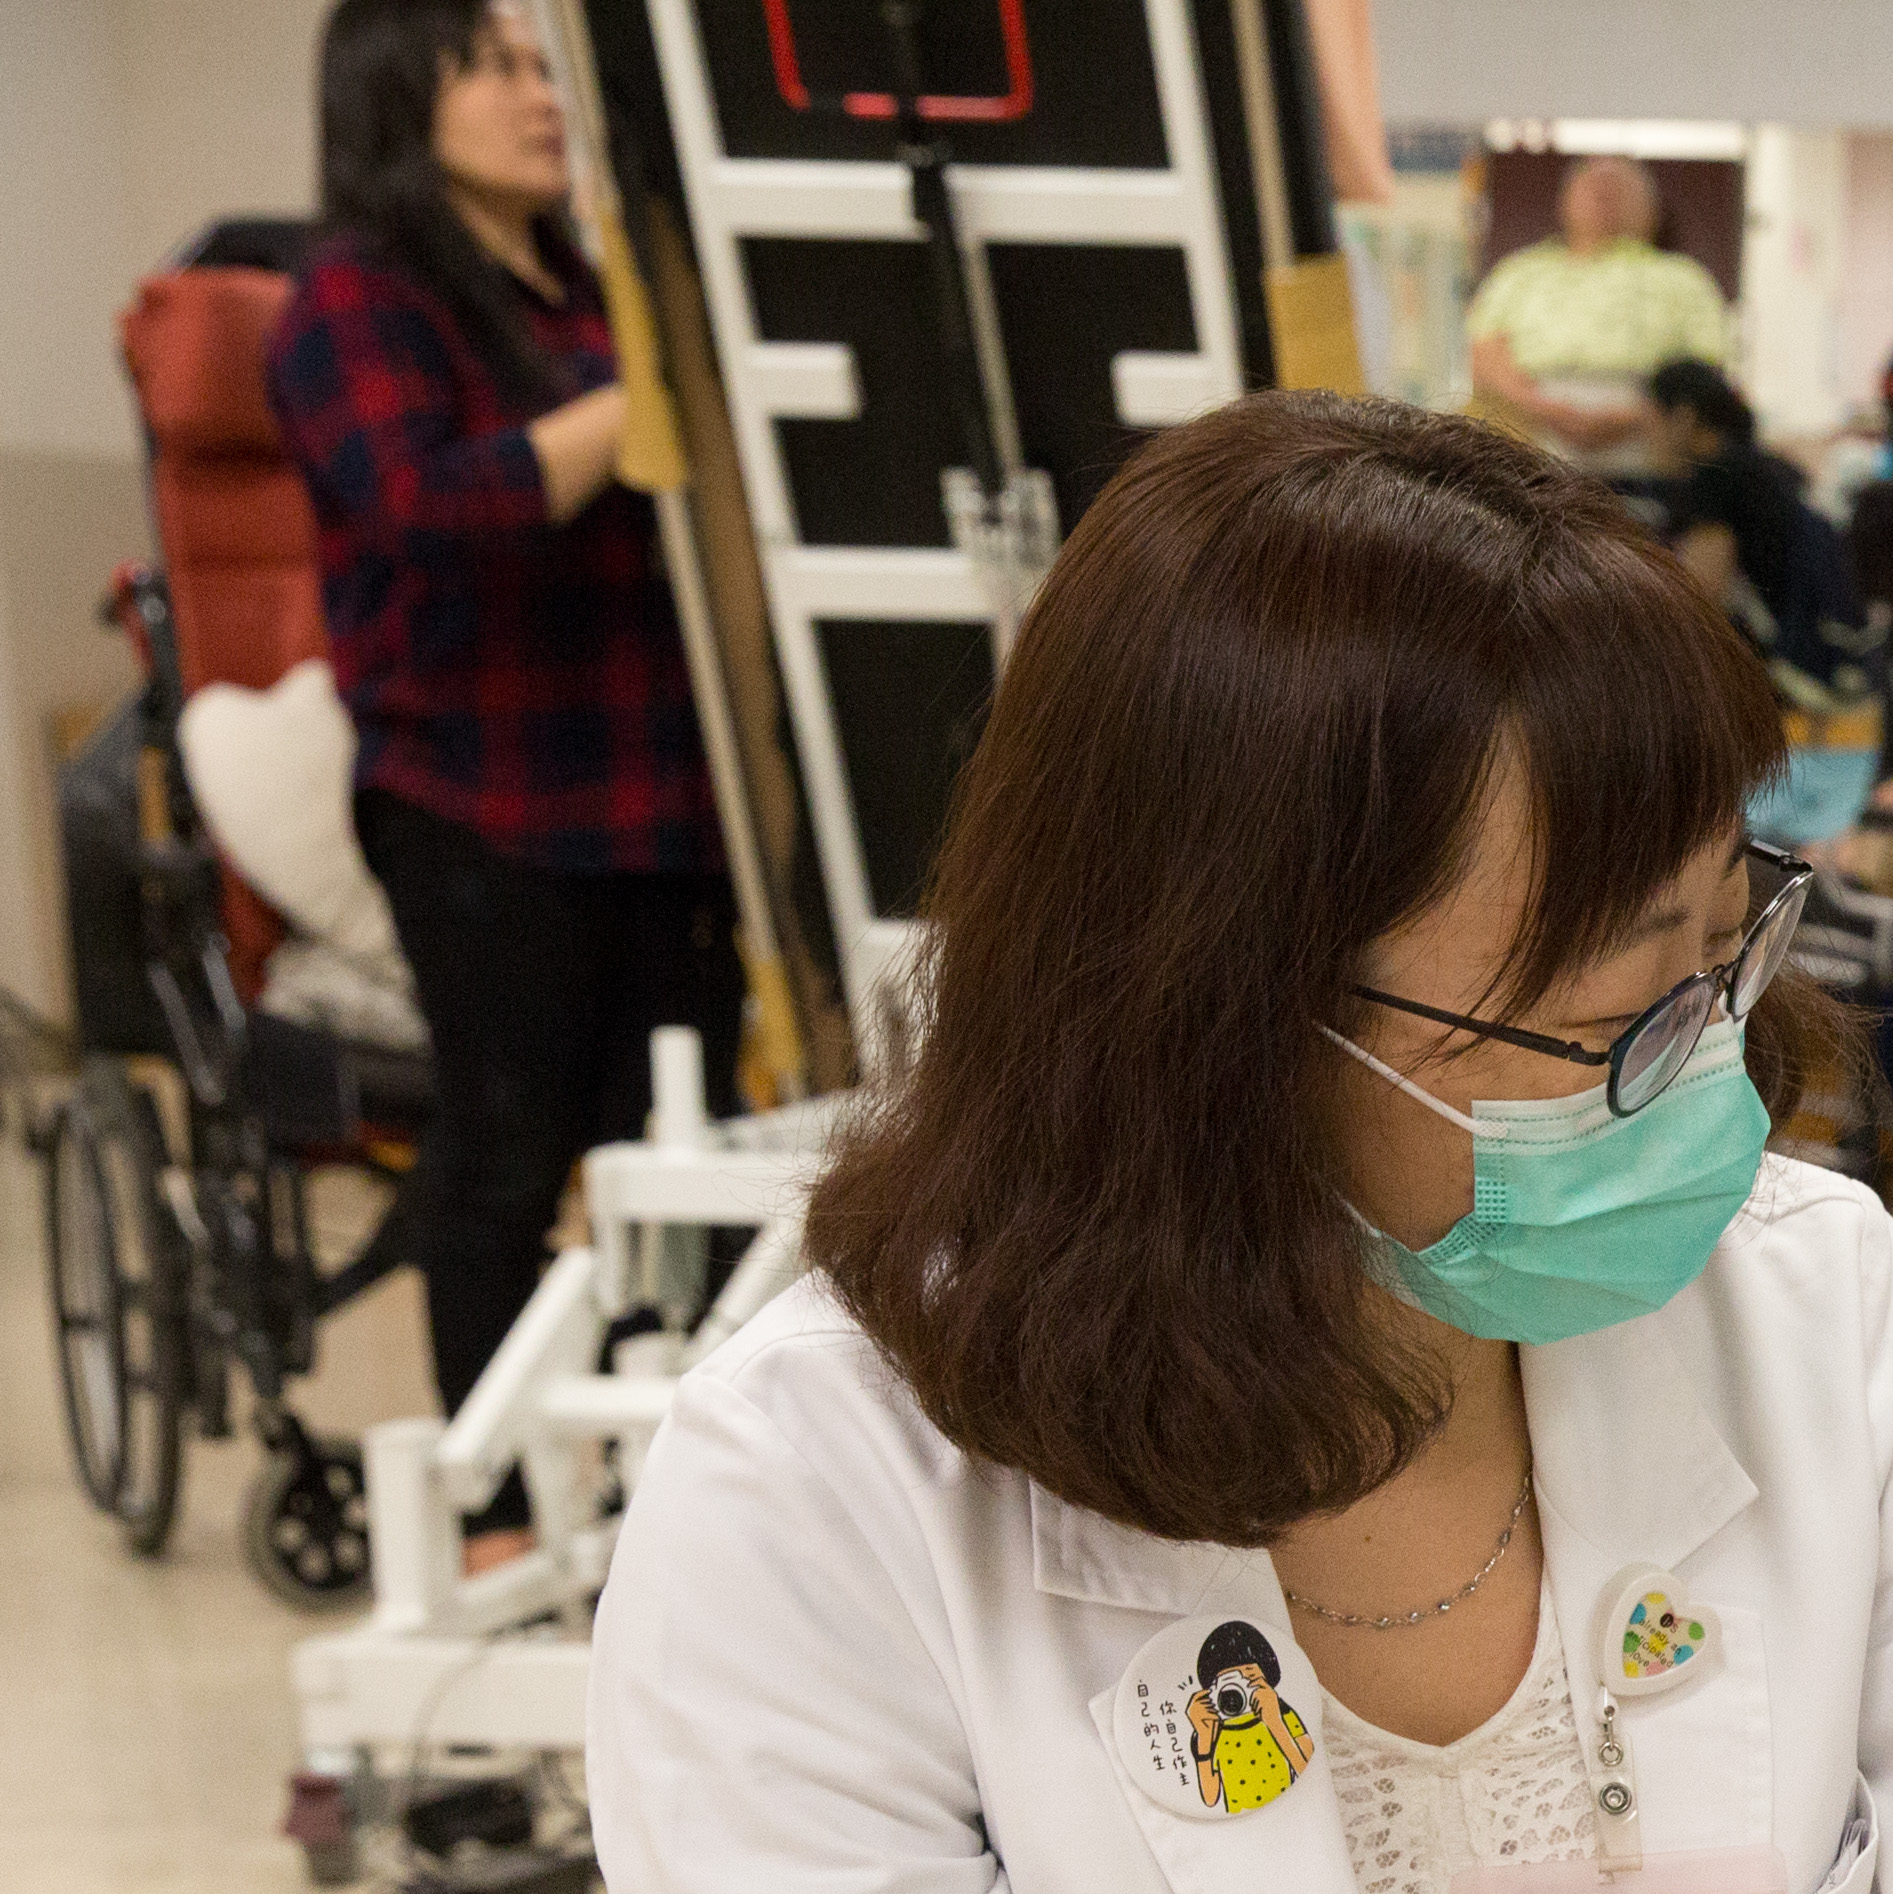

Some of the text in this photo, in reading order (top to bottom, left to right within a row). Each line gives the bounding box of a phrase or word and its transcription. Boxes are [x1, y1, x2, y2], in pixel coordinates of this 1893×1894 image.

[1626, 1631, 1673, 1668] anticipated
[1639, 1619, 1682, 1655] already an
[1137, 1679, 1165, 1771] 自己的人生
[1159, 1700, 1190, 1786] 你自己作主
